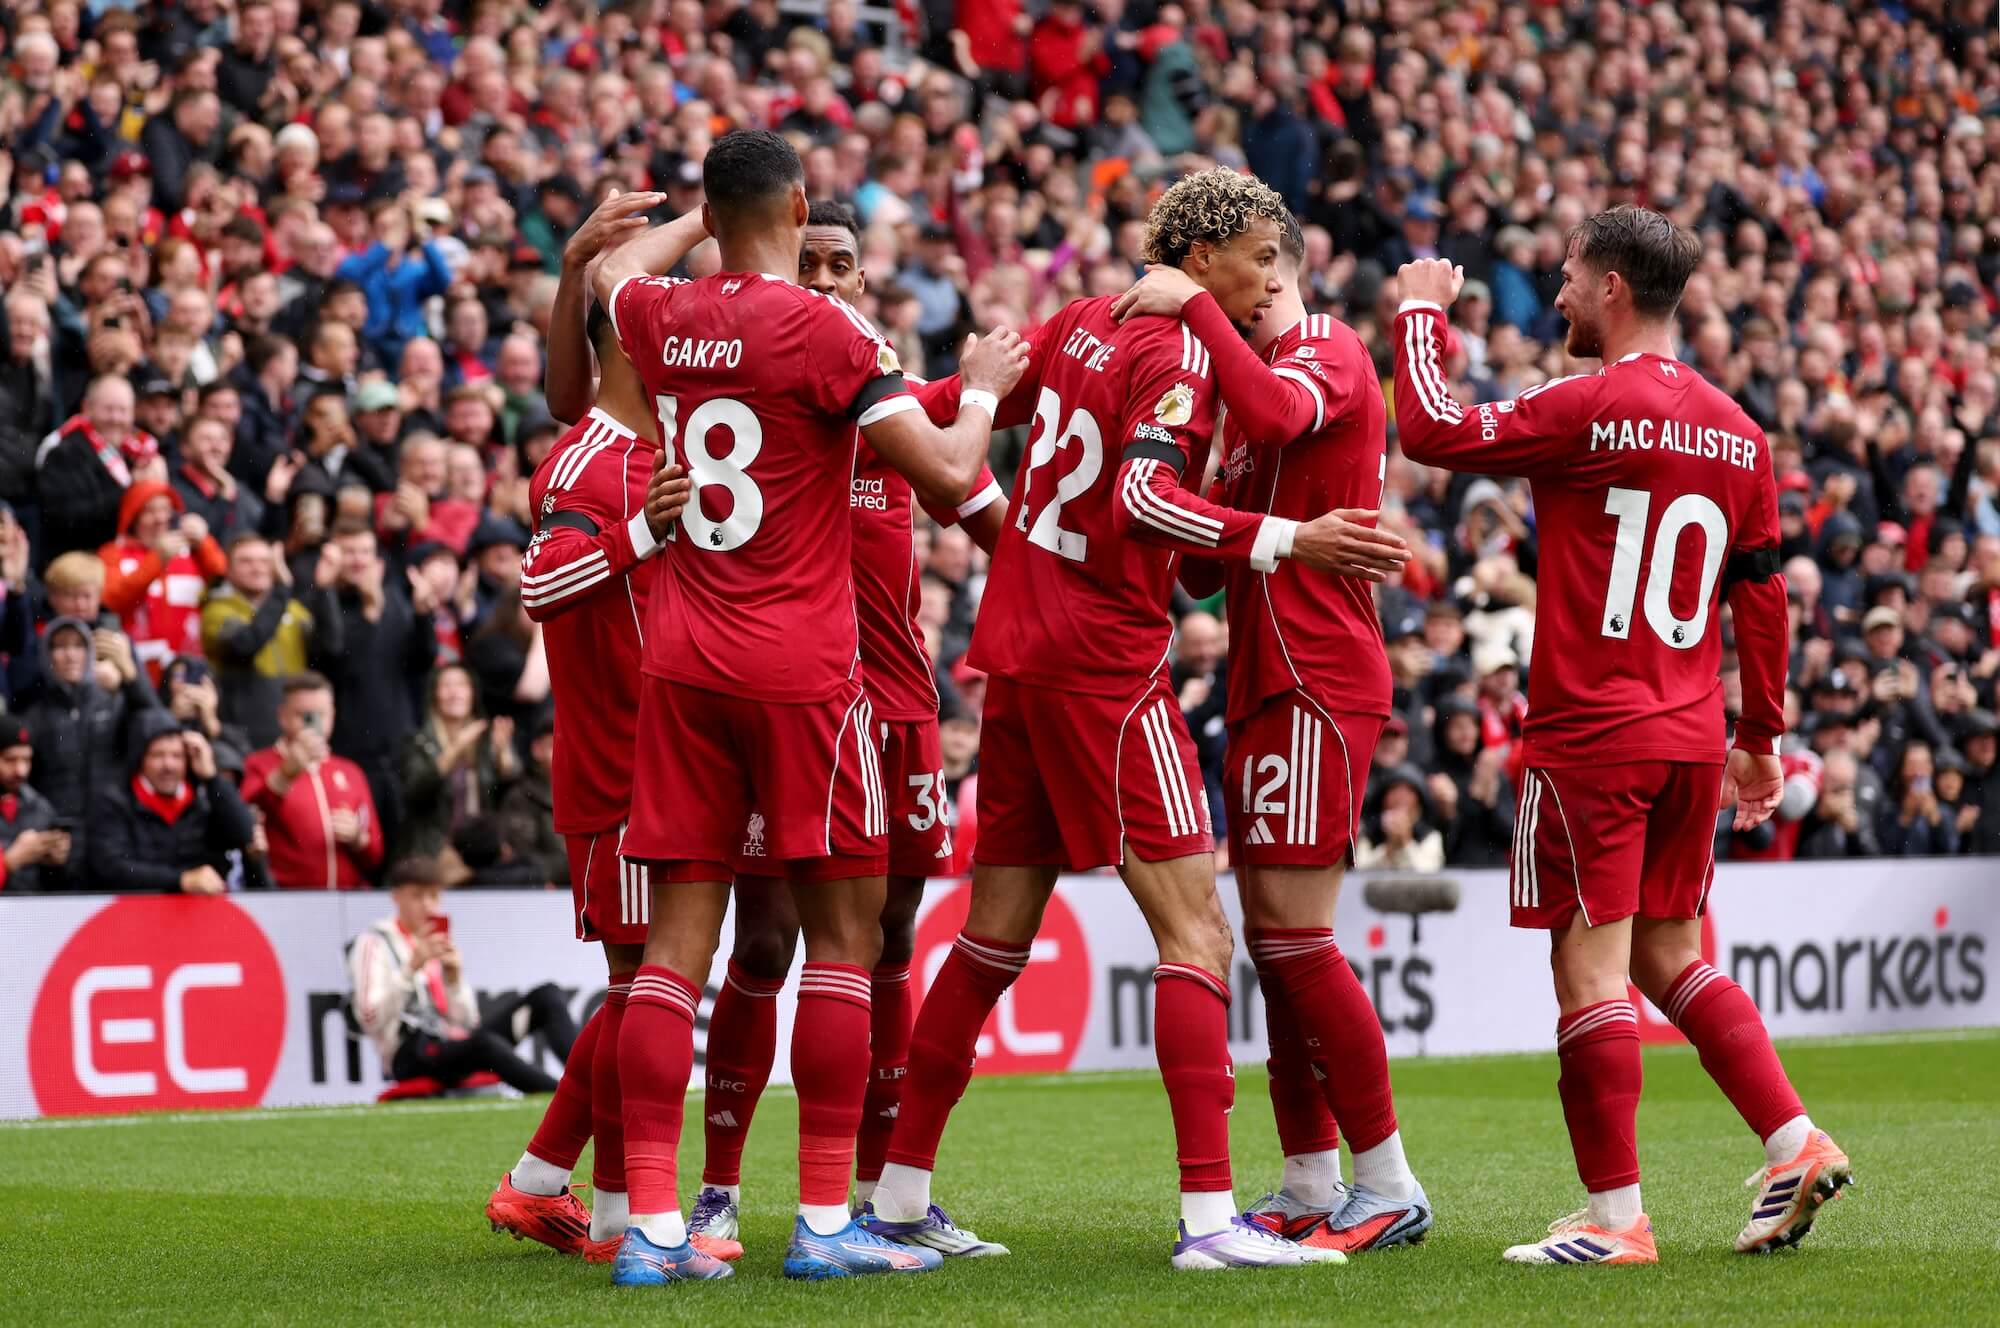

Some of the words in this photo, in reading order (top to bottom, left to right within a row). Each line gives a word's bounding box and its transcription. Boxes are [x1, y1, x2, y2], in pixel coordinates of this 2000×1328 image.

[662, 335, 743, 369] GAKPO
[1474, 402, 1499, 441] edia
[1590, 418, 1655, 451] MAC
[1659, 419, 1758, 472] ALLISTER
[655, 394, 765, 552] 18
[850, 494, 887, 511] ered
[852, 477, 884, 494] ard
[1015, 385, 1104, 563] 22
[1601, 486, 1729, 650] 10
[908, 768, 949, 832] 38
[1242, 754, 1289, 814] 12
[1731, 906, 1986, 1015] markets
[70, 962, 248, 1097] EC
